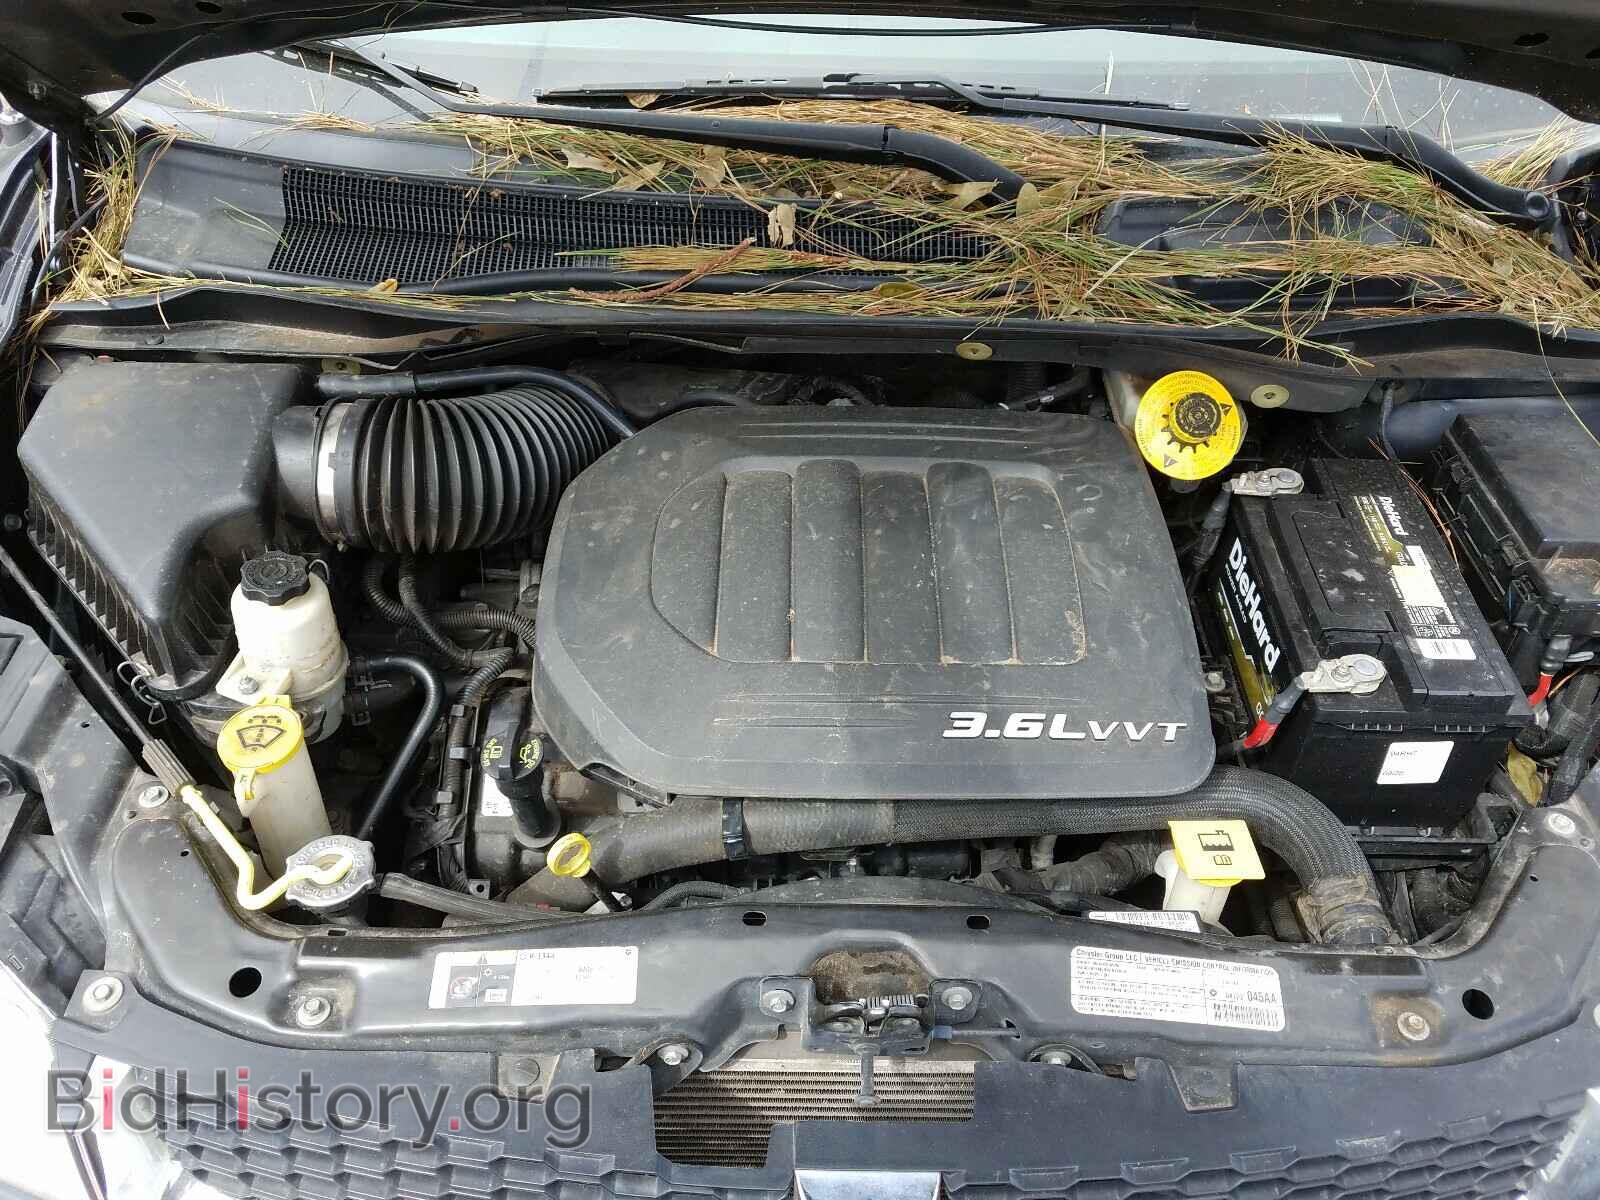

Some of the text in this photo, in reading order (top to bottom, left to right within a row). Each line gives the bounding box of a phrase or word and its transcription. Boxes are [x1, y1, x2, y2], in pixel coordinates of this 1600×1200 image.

[1378, 496, 1410, 536] DieHard
[1228, 536, 1281, 674] DieHard
[1104, 951, 1124, 961] Group
[1171, 958, 1200, 968] EMISSION
